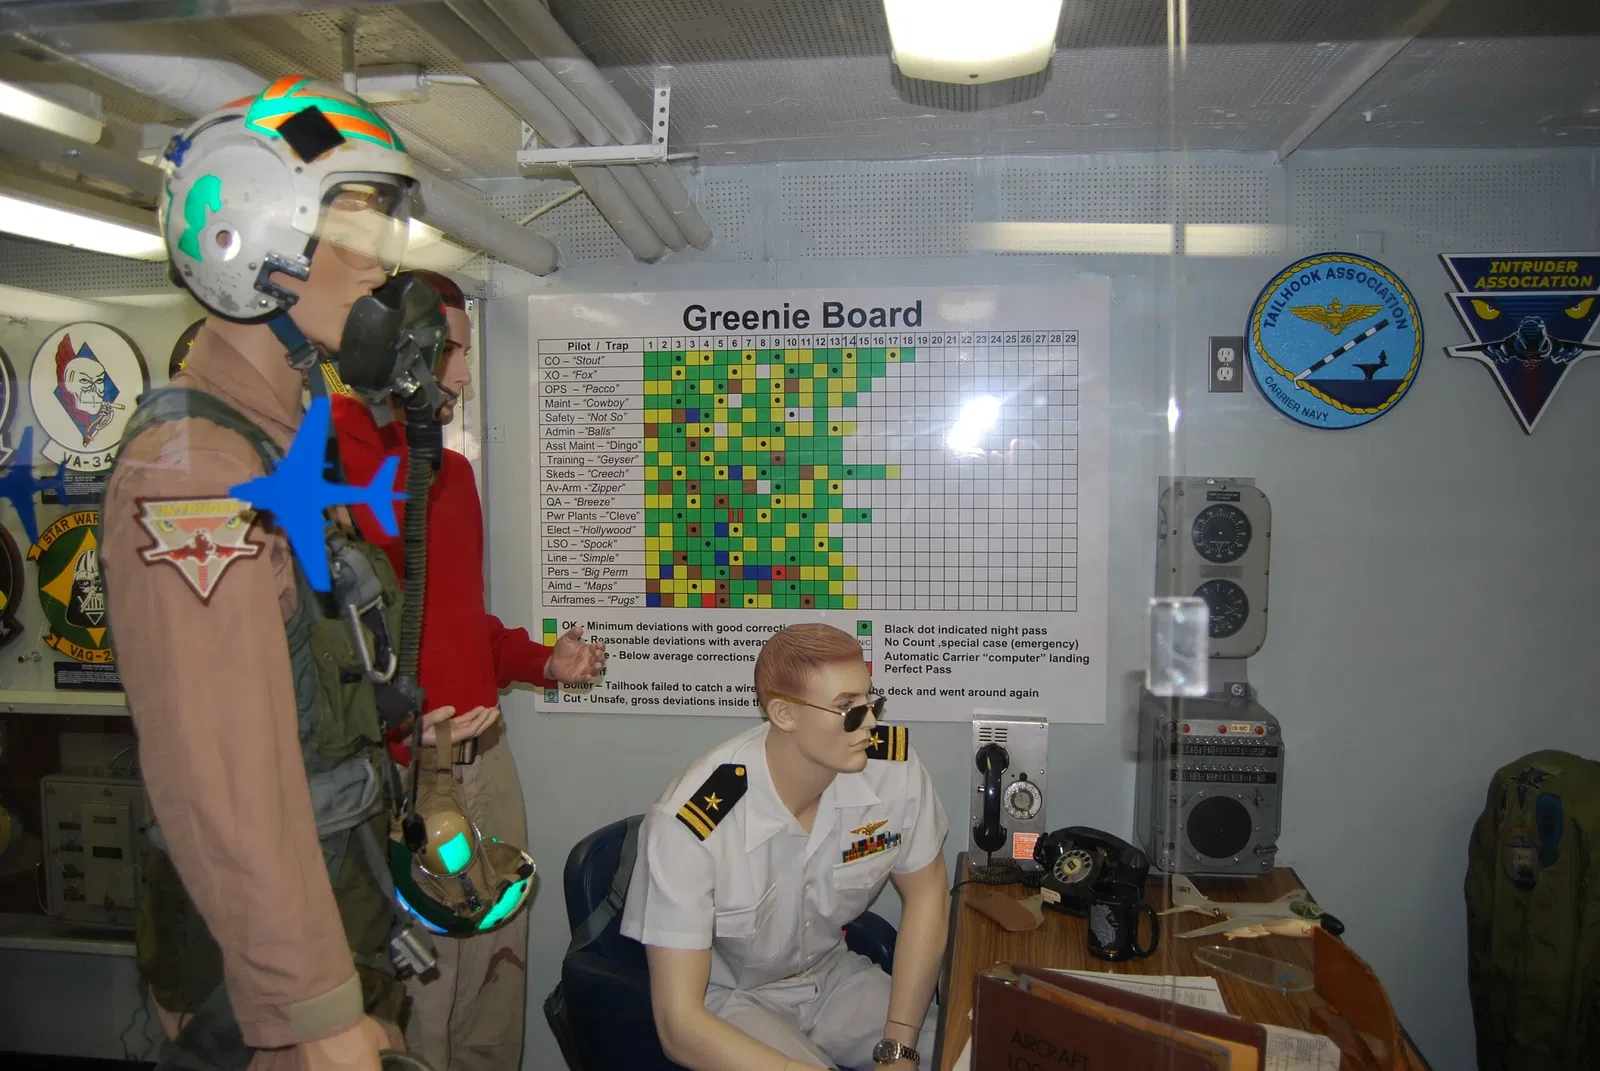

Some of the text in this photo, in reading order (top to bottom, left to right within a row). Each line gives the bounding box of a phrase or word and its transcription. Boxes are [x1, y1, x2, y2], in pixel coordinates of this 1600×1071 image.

[1490, 260, 1578, 273] INTRUDER
[1474, 275, 1593, 288] ASSOCIATION
[1264, 267, 1408, 330] TAILHOOK ASSOCIATION
[683, 300, 922, 331] Greenie Board
[648, 334, 1076, 349] 1 2 3 3 4 5 6 7 8 9 10 11 12 13 14 15 16 17 18 19 20 21 22 23 24 25 26 27 28 29
[568, 342, 591, 351] Pilot
[606, 342, 629, 352] Trap
[544, 356, 560, 365] CO
[544, 371, 560, 379] XO
[545, 385, 567, 394] OPS
[545, 400, 571, 408] Maint
[1265, 376, 1329, 422] CARRIER NAVY
[545, 413, 575, 424] Safety
[545, 428, 575, 436] Admin
[546, 442, 566, 450] Asst
[569, 441, 595, 450] Maint
[547, 456, 585, 466] Training
[546, 470, 575, 478] Skeds
[546, 484, 581, 492] Av-Arm
[546, 498, 561, 506] QA
[547, 512, 564, 520] Pwr
[568, 512, 597, 520] Plants
[43, 519, 70, 544] STAR
[547, 526, 570, 534] Elect
[547, 540, 568, 548] LSO
[548, 554, 567, 562] Line
[548, 567, 569, 576] Pers
[603, 568, 628, 576] Perm
[548, 581, 572, 589] Aimd
[550, 595, 595, 604] Airframes
[587, 622, 633, 630] Minimum
[636, 622, 689, 632] deviations
[692, 623, 713, 632] with
[716, 624, 743, 634] good
[884, 625, 1048, 637] Black dot indicated night pass
[653, 636, 706, 646] deviations
[709, 637, 730, 646] with
[884, 638, 899, 647] No
[902, 638, 935, 647] Count
[983, 641, 1008, 649] case
[1011, 639, 1079, 650] (emergency)
[619, 651, 650, 660] Below
[653, 652, 693, 662] average
[696, 652, 755, 662] corrections
[884, 652, 939, 662] Automatic
[942, 653, 979, 662] Carrier
[1050, 654, 1090, 665] landing
[884, 664, 952, 674] Perfect Pass
[605, 681, 648, 691] Tailhook
[651, 682, 679, 691] failed
[695, 683, 723, 692] catch
[735, 684, 756, 692] wire
[870, 686, 884, 695] he
[888, 687, 913, 696] deck
[916, 687, 936, 696] and
[939, 688, 965, 697] went
[968, 688, 1006, 697] around
[1010, 689, 1039, 699] again
[564, 694, 581, 703] Cut
[590, 695, 628, 705] Unsafe,
[631, 698, 659, 706] gross
[663, 696, 715, 706] deviations
[718, 697, 750, 707] inside
